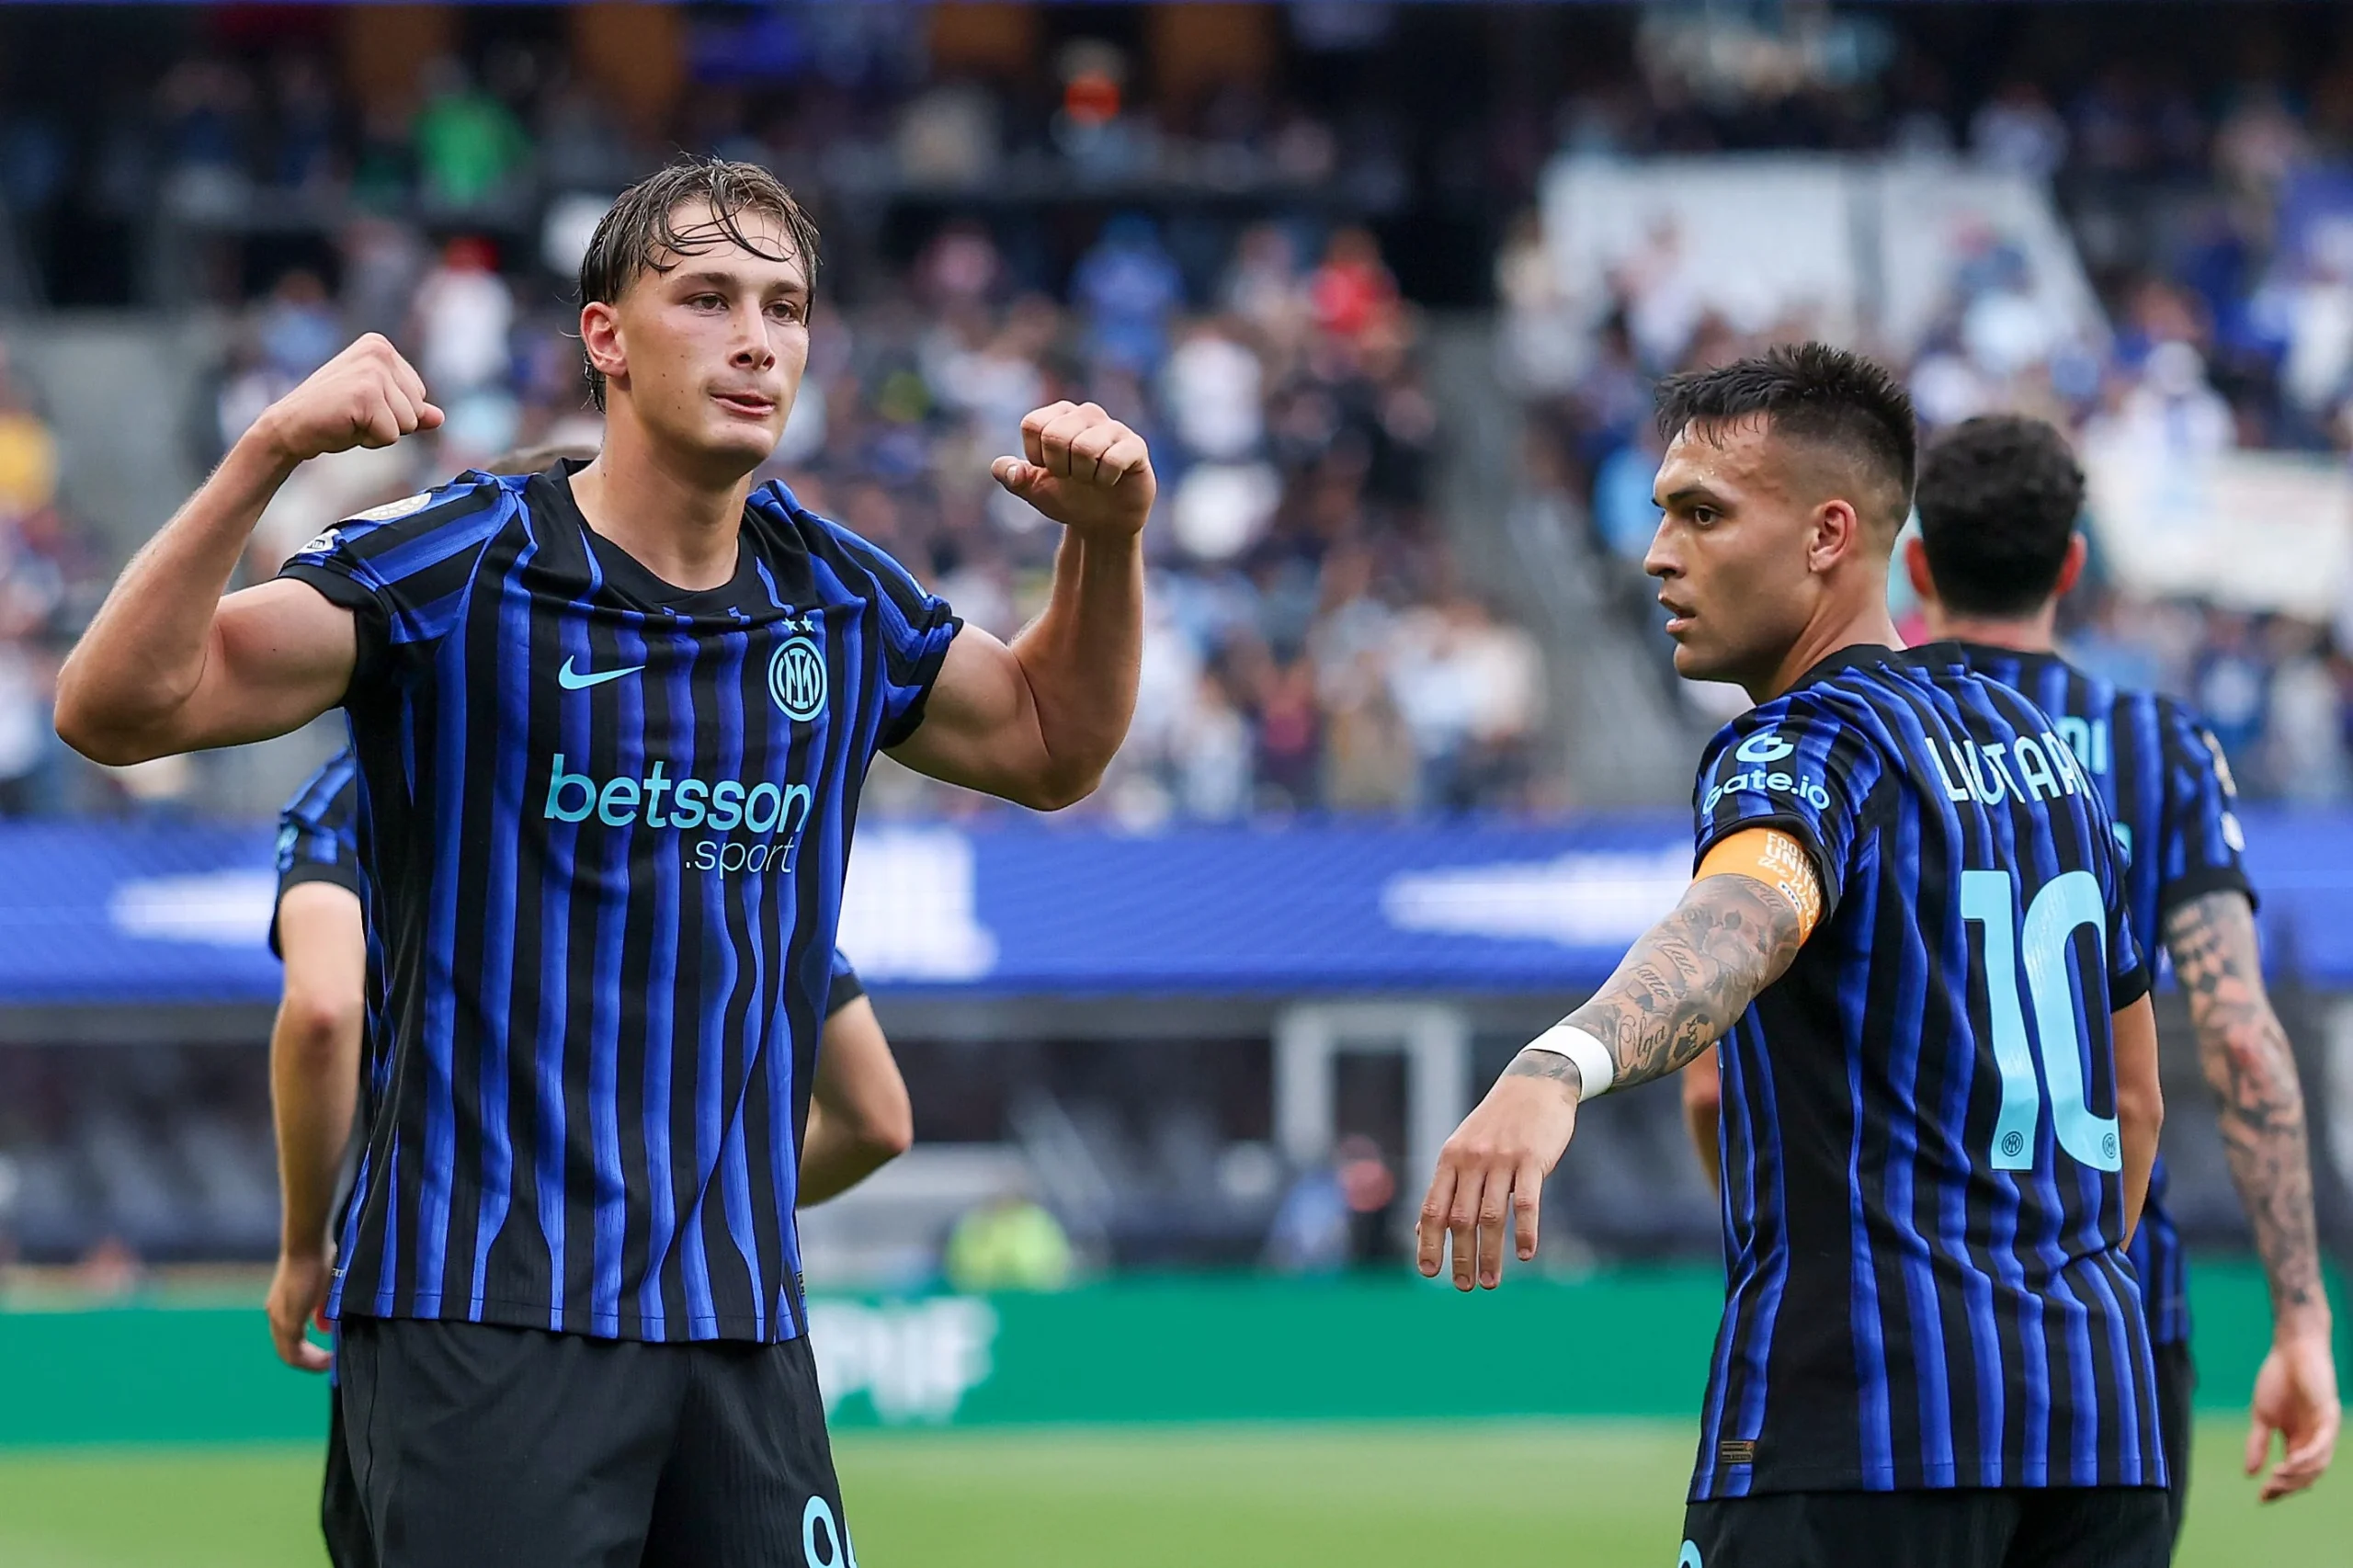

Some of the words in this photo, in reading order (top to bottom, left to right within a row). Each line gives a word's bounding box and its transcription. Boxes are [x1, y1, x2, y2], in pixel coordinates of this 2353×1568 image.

[544, 754, 811, 833] betsson
[1925, 732, 2092, 806] LUTAR
[686, 837, 794, 880] .sport
[1960, 869, 2123, 1173] 10
[802, 1495, 858, 1568] 9
